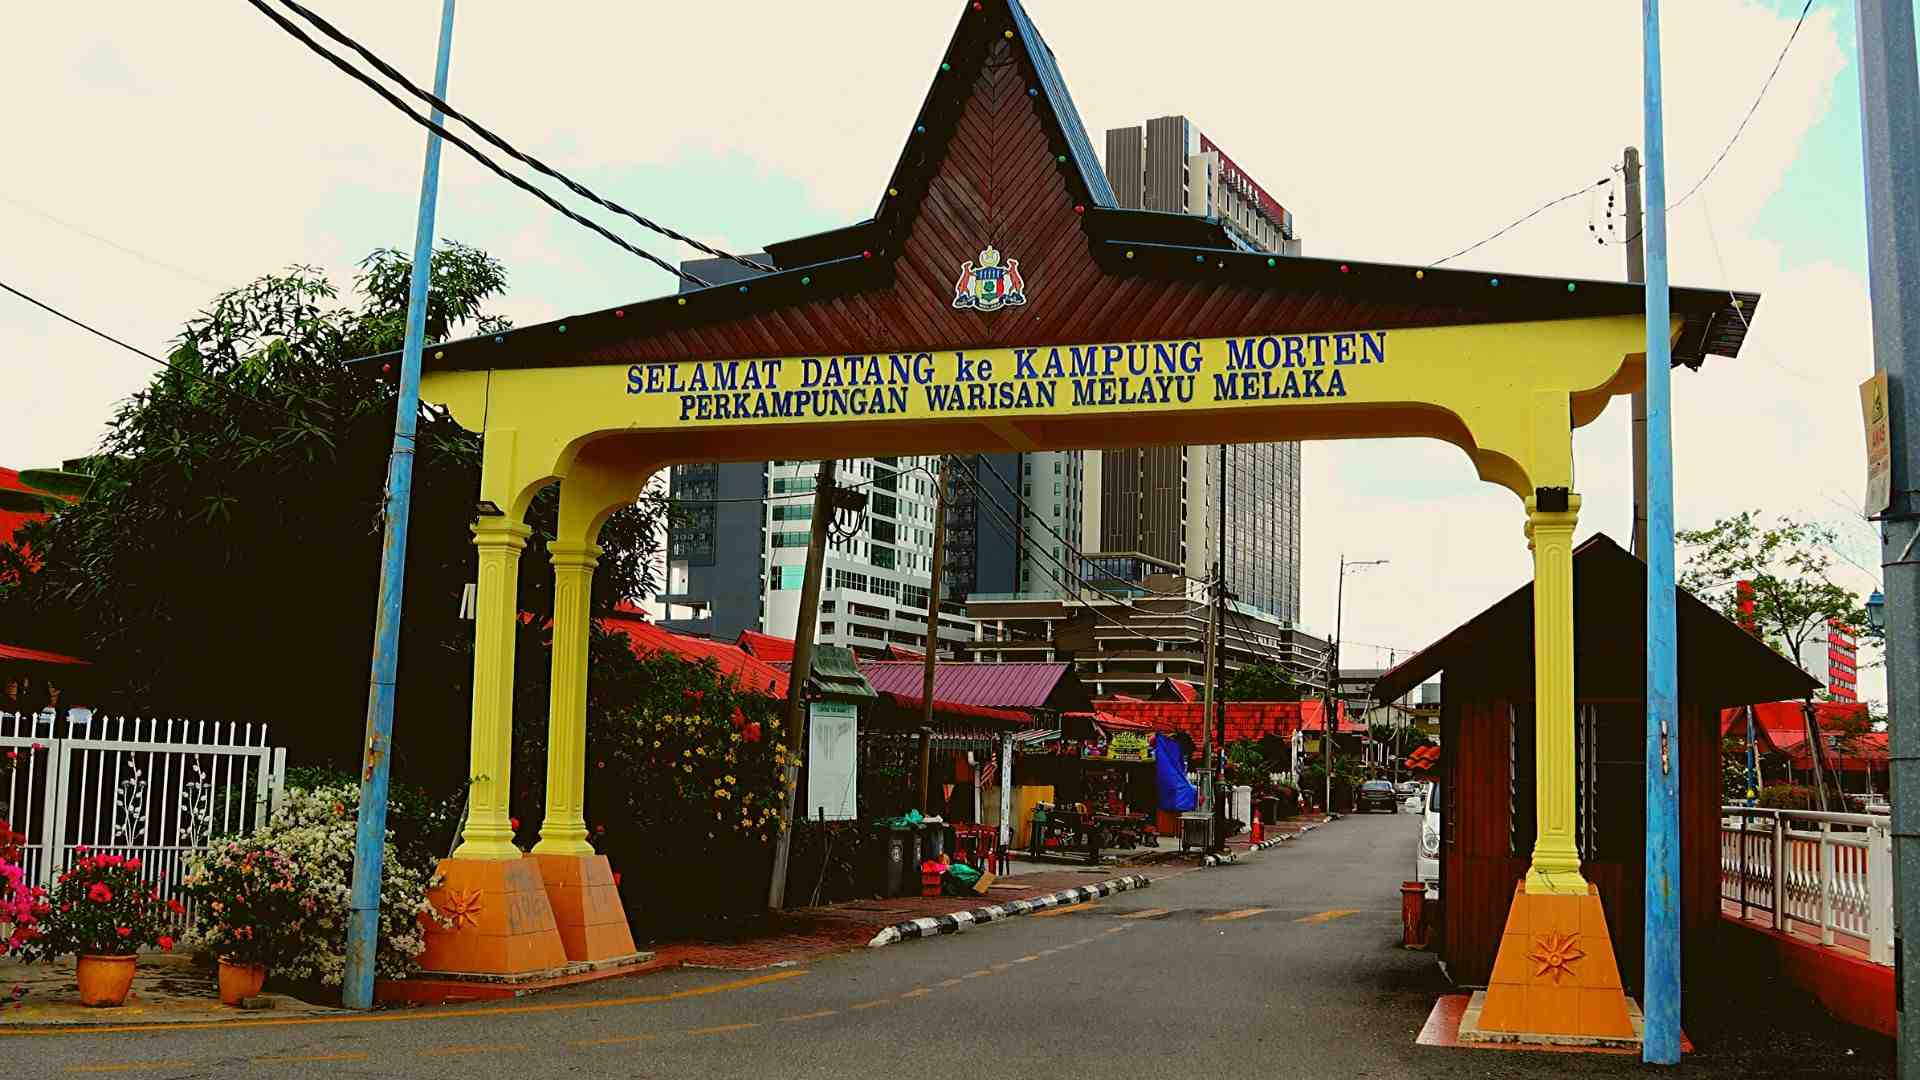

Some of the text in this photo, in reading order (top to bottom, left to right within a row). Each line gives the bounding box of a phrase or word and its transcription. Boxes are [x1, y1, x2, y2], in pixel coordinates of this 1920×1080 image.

[627, 332, 1386, 394] SELAMAT DATANG ke KAMPUNG MORTEN
[679, 370, 1347, 420] PERKAMPUNGAN WARISAN MELAYU MELAKA
